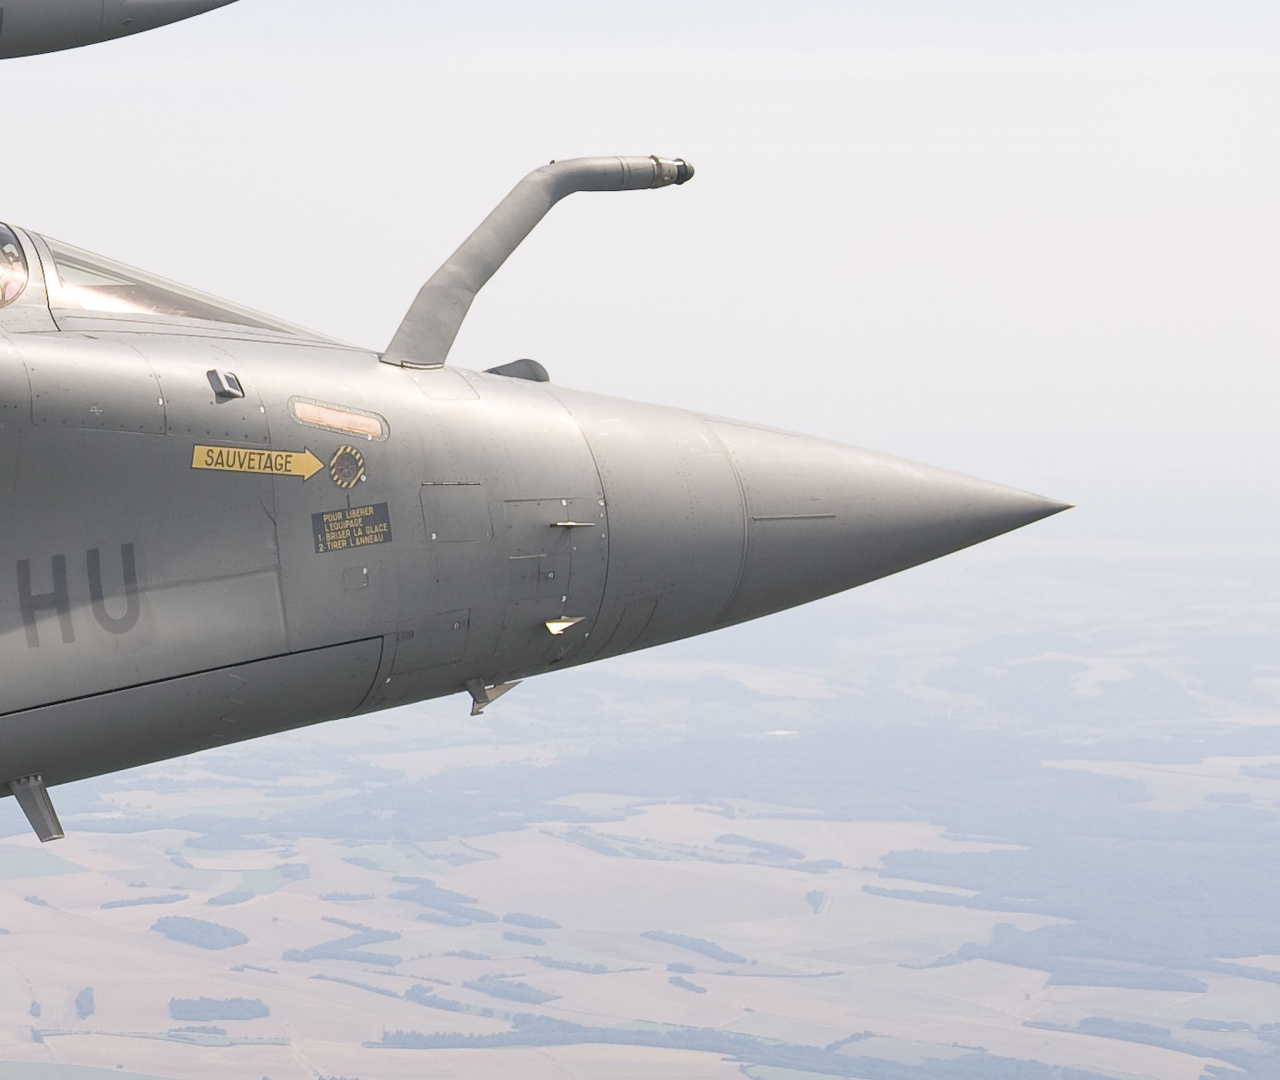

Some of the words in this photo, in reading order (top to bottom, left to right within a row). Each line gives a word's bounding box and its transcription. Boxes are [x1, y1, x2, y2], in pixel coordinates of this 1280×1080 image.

[204, 448, 293, 472] SAUVETAGE
[323, 511, 343, 523] POUR
[345, 506, 374, 520] LIBERER
[353, 527, 363, 537] LA
[365, 522, 389, 535] GLACE
